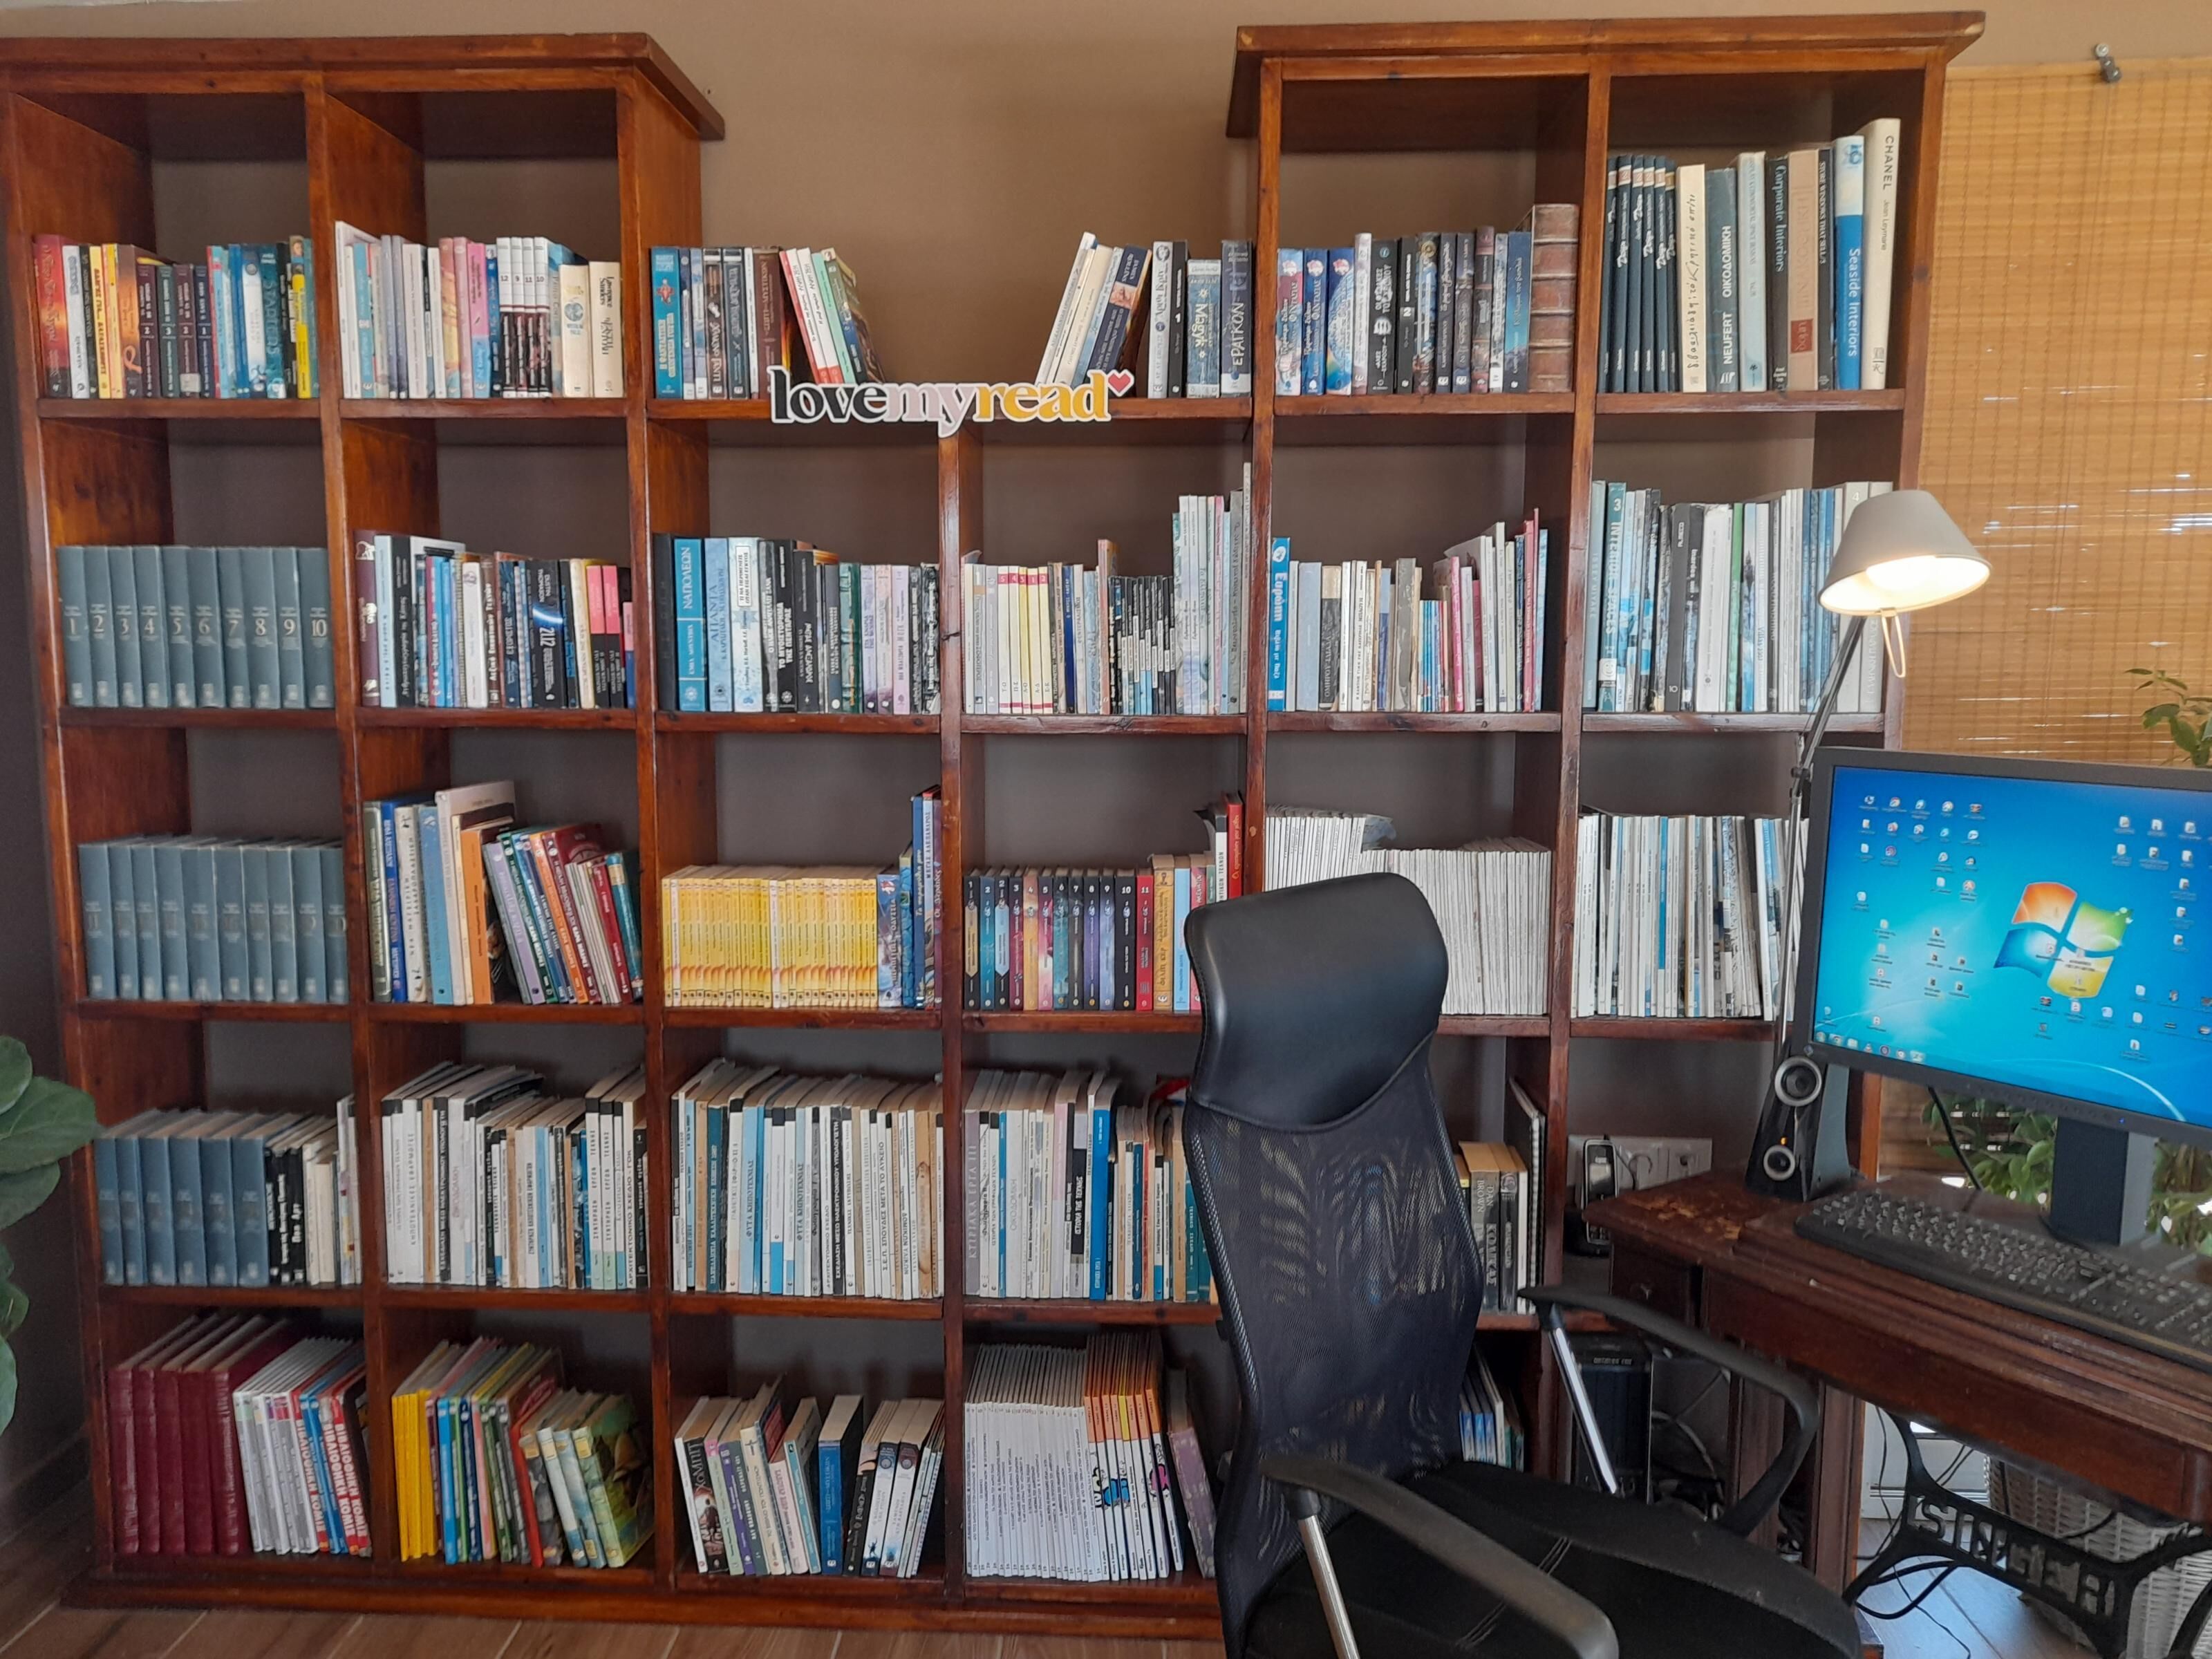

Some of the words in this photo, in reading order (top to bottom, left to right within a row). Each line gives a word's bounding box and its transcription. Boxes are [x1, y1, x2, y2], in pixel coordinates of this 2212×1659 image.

[1883, 135, 1895, 189] CHANEL
[1774, 165, 1786, 222] Corporate
[1722, 225, 1732, 298] ΟΙΚΟΔΟΜΙΚΗ
[1849, 248, 1862, 298] Seaside
[1192, 303, 1208, 348] Magyk
[1724, 312, 1733, 365] NEUFERT
[1848, 301, 1860, 357] Interiors
[1613, 498, 1621, 511] 3
[683, 547, 692, 610] ΝΑΠΟΛΕΩΝ
[1273, 572, 1288, 621] Ευρώπη
[70, 619, 77, 633] 1
[94, 615, 104, 632] 2
[120, 619, 130, 635] 3
[144, 619, 154, 635] 4
[174, 618, 182, 634] 5
[198, 618, 211, 635] 6
[227, 619, 239, 636] 7
[255, 619, 266, 635] 8
[283, 619, 296, 635] 9
[311, 619, 327, 637] 10
[785, 608, 793, 646] ΠΕΝΤΑΡΑΣ
[1606, 587, 1617, 634] SPACES
[879, 1172, 885, 1183] ΤΟ
[1486, 1184, 1494, 1207] DAN
[1477, 1179, 1485, 1214] BROWN
[297, 1418, 317, 1491] ΒΙΒΛΙΟΘΗΚΗ
[323, 1423, 346, 1495] ΒΙΒΛΙΟΘΗΚΗ
[335, 1423, 359, 1496] ΒΙΒΛΙΟΘΗΚΗ
